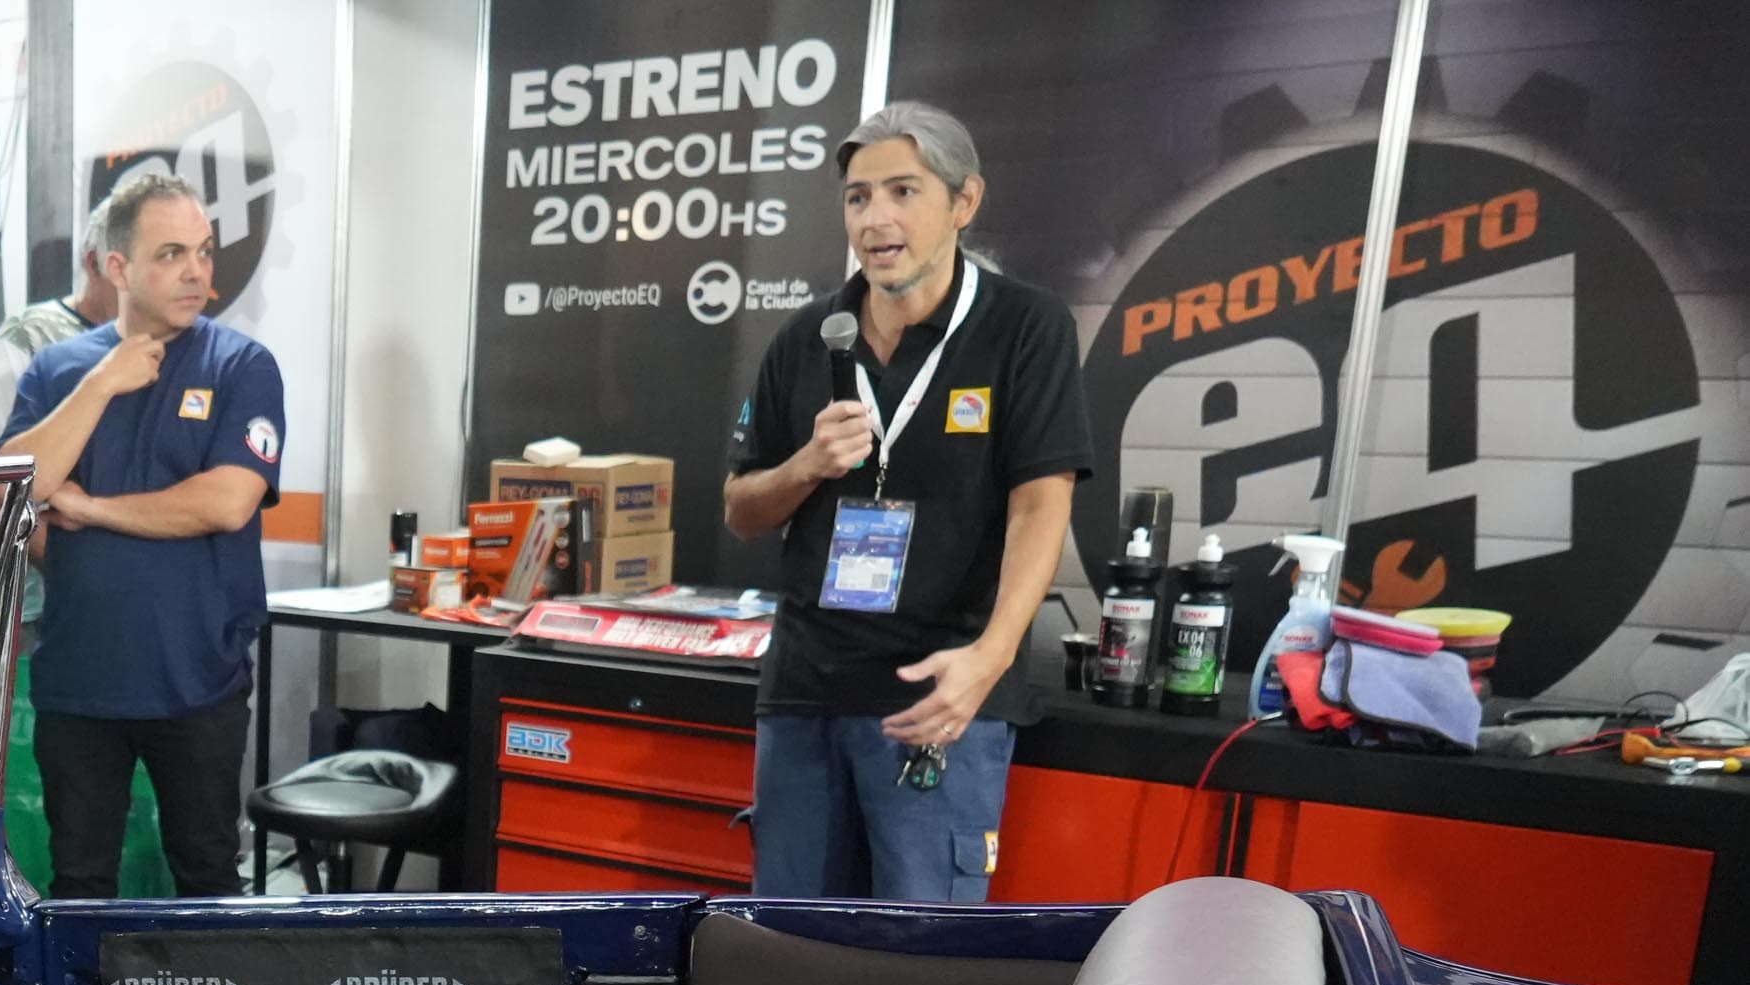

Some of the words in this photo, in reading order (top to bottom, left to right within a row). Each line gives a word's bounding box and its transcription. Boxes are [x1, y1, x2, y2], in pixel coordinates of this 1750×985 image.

[508, 38, 836, 130] ESTRENO
[505, 125, 827, 188] MIERCOLES
[530, 187, 787, 245] 20:00HS
[545, 283, 661, 312] /@ProyectoEQ
[745, 294, 760, 309] la
[746, 280, 787, 295] Canal
[791, 278, 809, 294] de
[1122, 188, 1539, 357] PROYECTO
